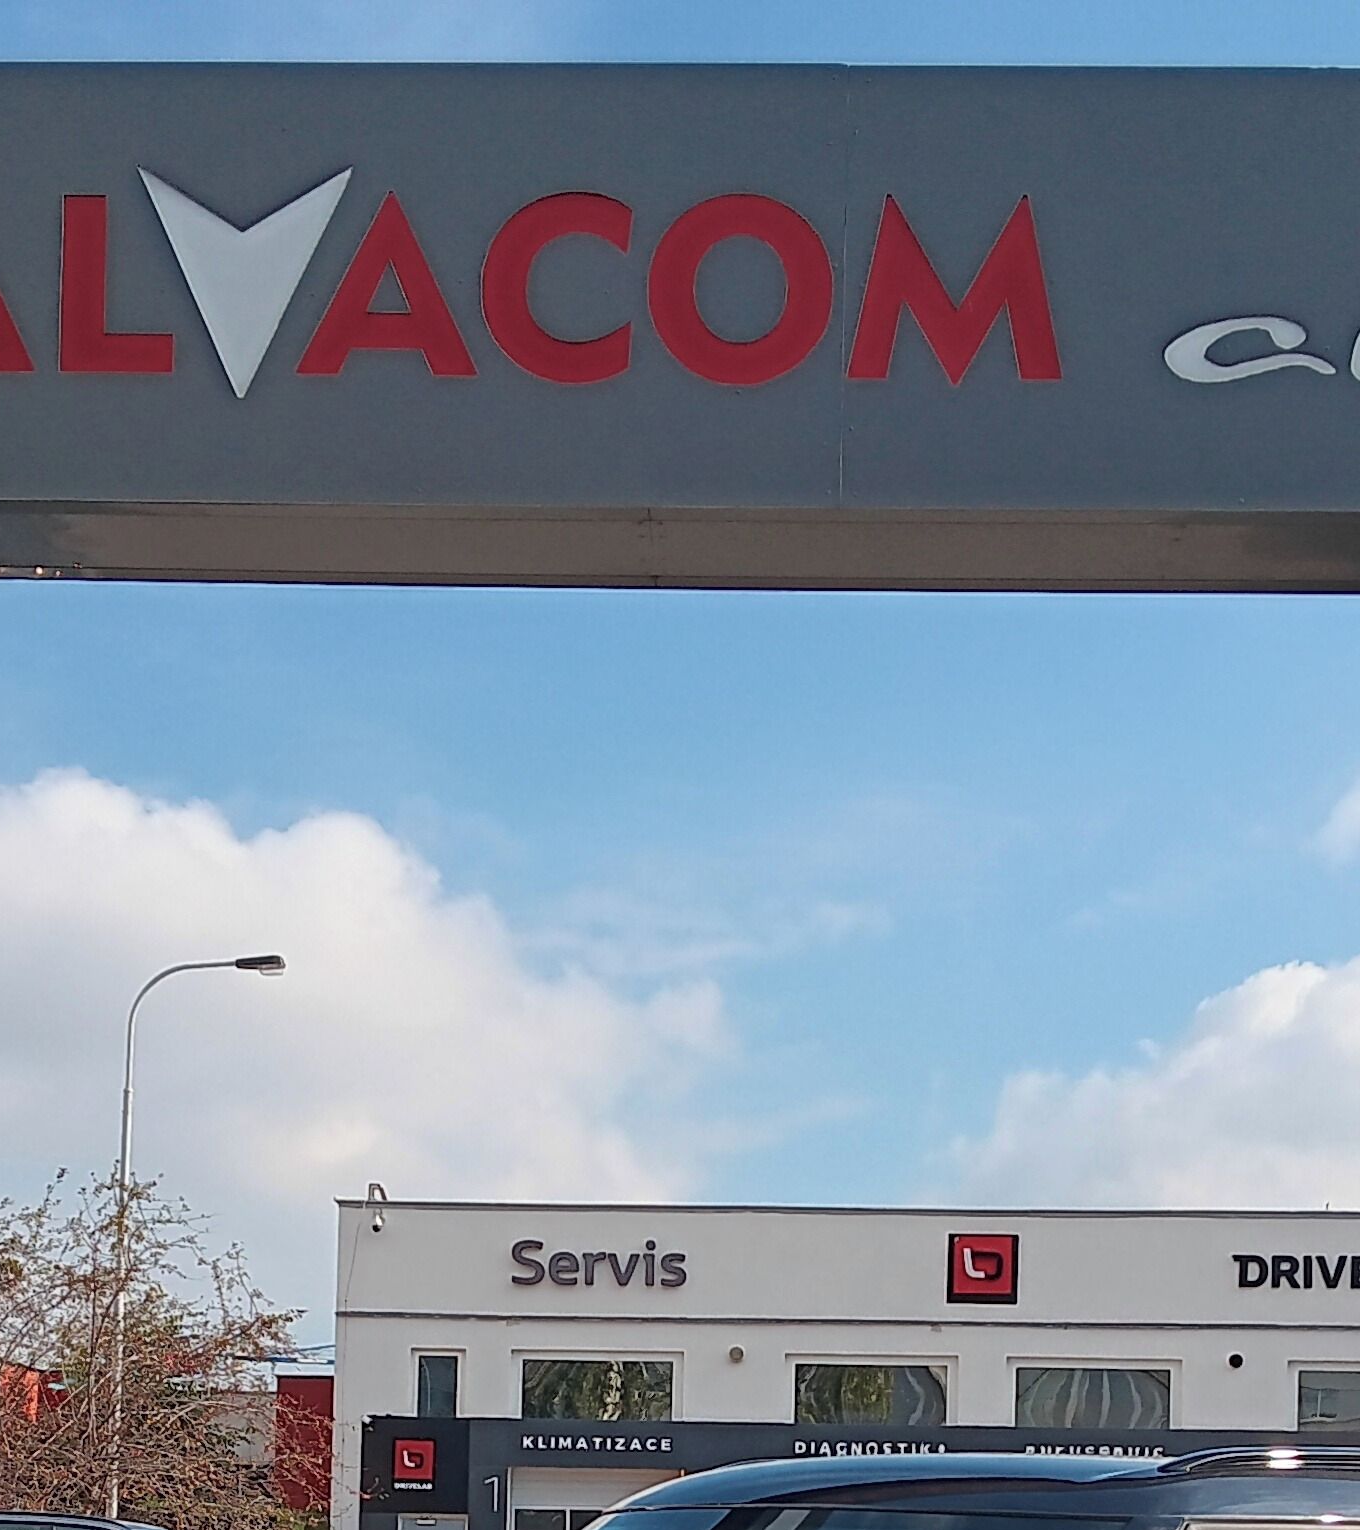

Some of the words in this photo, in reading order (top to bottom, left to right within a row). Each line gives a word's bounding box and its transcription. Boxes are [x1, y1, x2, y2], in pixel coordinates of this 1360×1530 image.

[511, 1239, 688, 1287] Servis
[522, 1436, 672, 1451] KLIMATIZACE
[394, 1482, 433, 1490] DRIVELAB
[484, 1476, 499, 1512] 1
